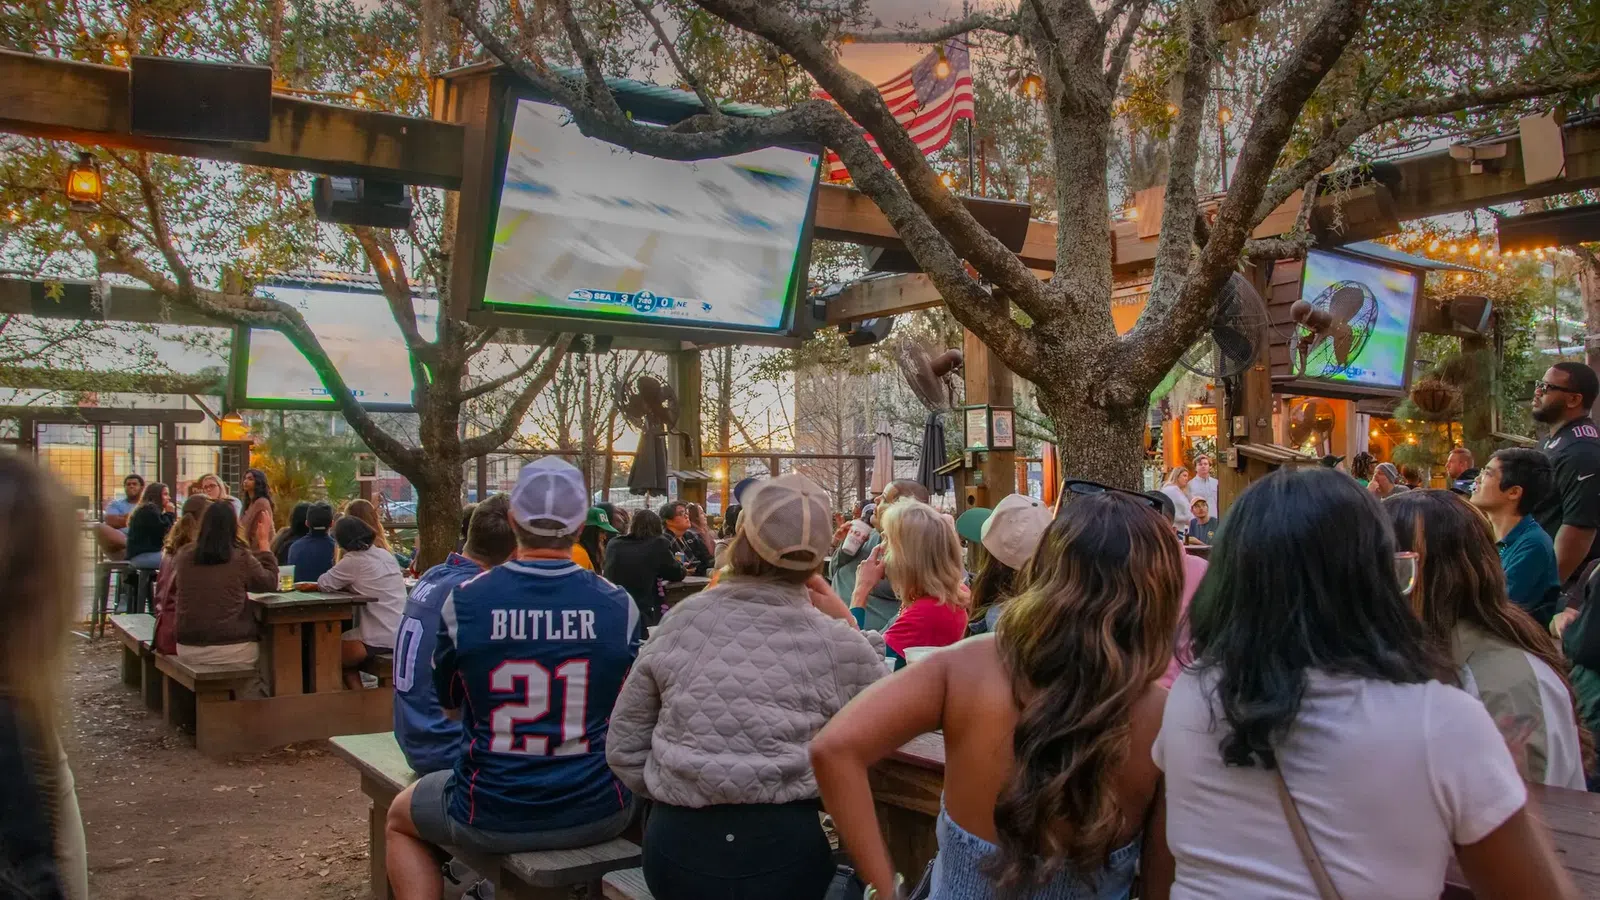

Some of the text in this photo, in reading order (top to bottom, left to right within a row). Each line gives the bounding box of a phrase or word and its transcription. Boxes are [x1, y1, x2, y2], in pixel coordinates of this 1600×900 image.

[593, 292, 629, 303] SEA 3
[660, 298, 669, 307] 0
[1187, 413, 1217, 426] SMOK
[1571, 425, 1598, 438] 10
[490, 608, 597, 640] BUTLER
[393, 614, 424, 693] 0
[489, 658, 590, 757] 21
